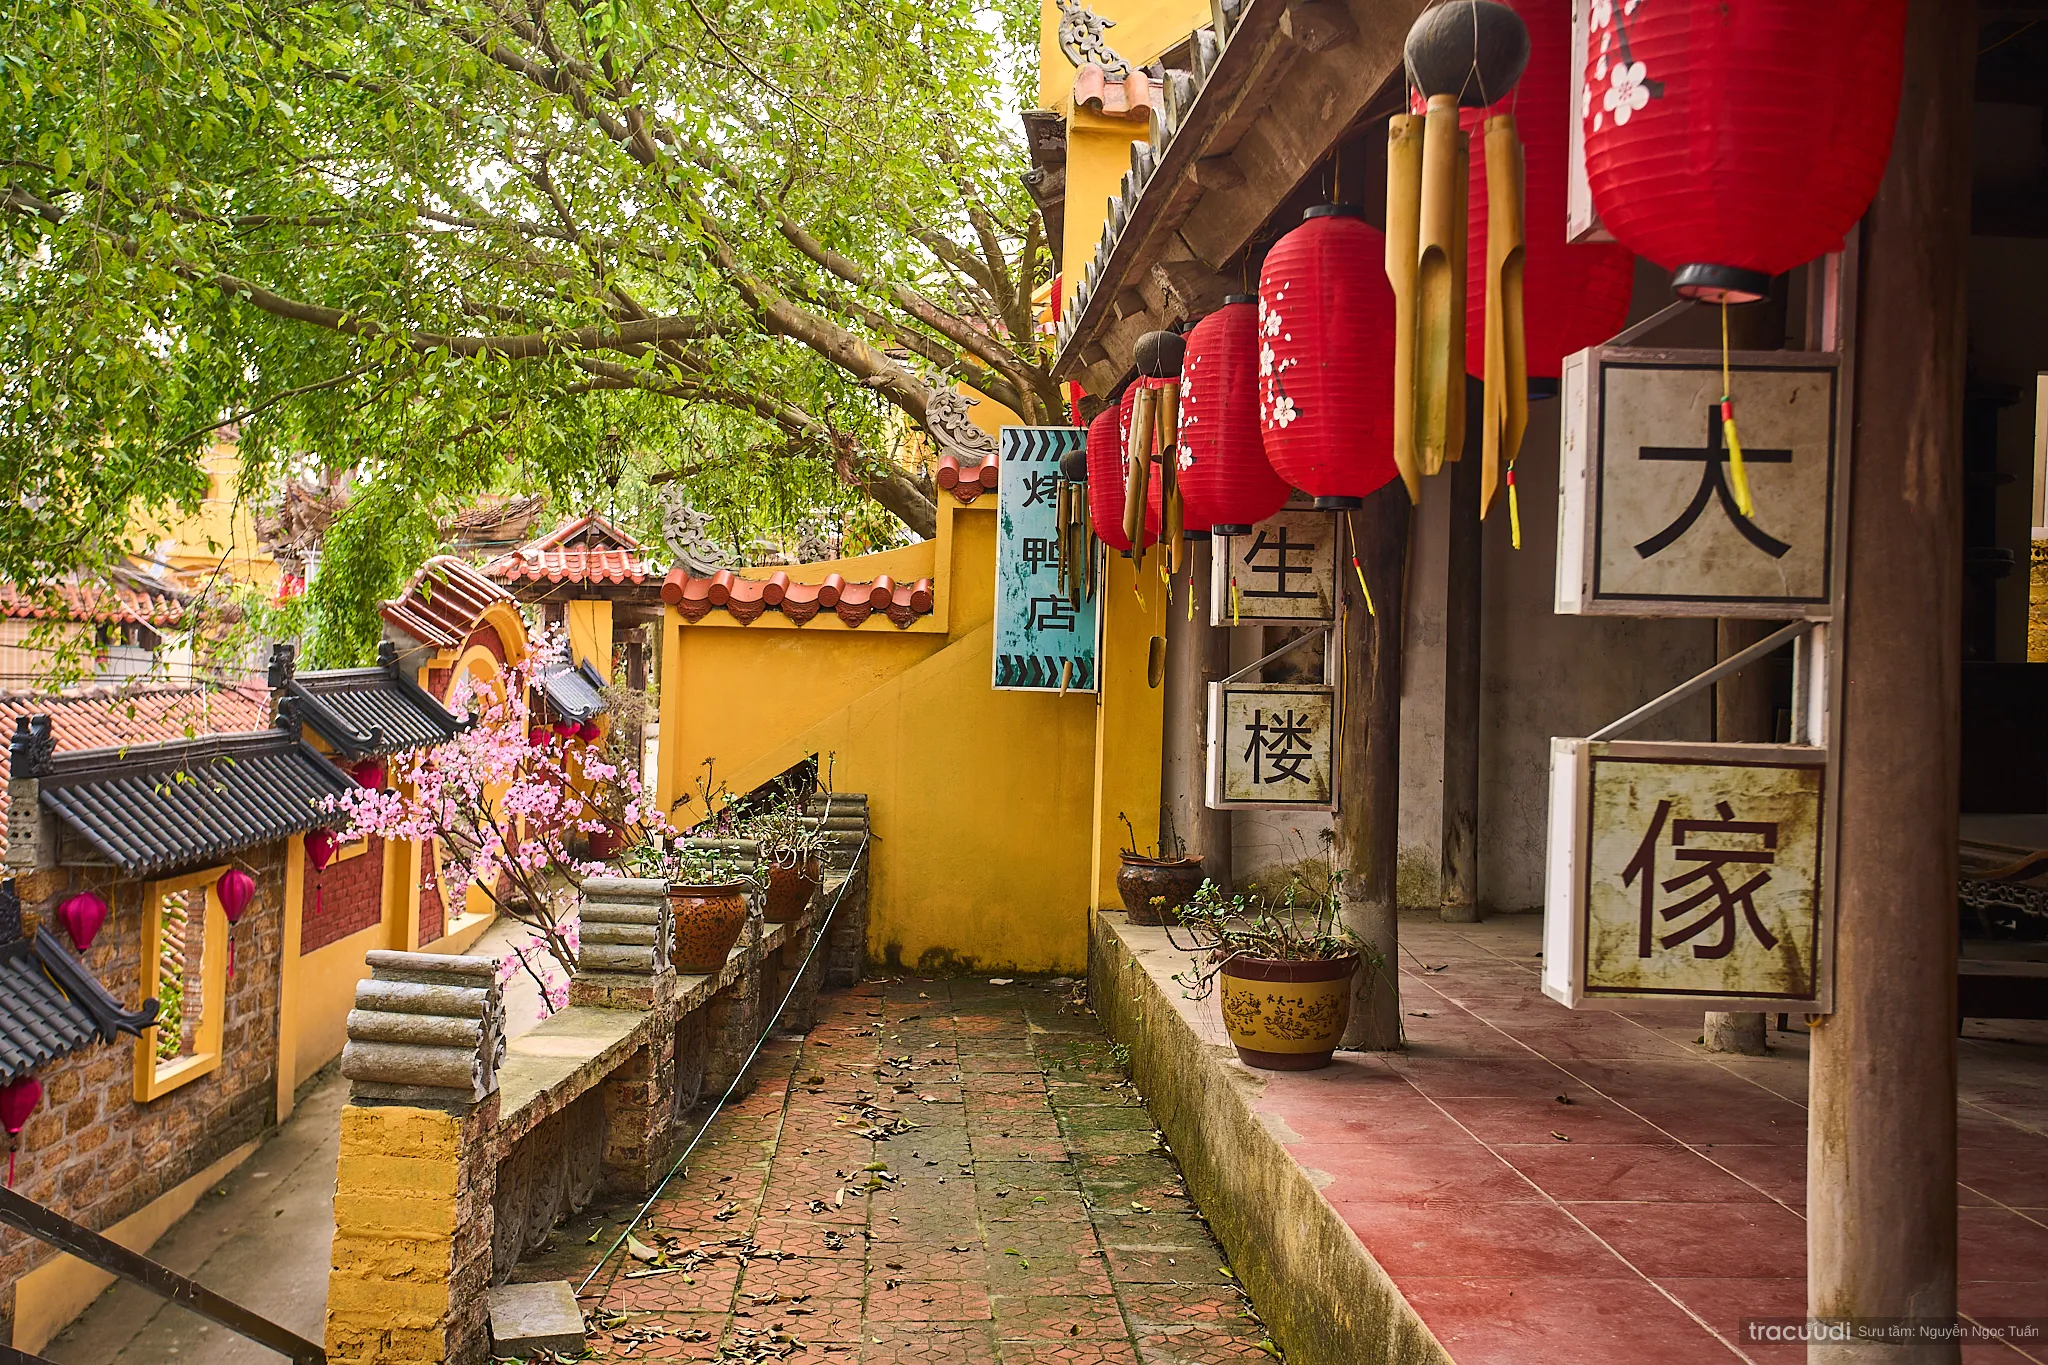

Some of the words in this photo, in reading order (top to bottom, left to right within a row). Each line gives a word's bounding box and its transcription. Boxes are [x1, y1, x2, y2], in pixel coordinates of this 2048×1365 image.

[1634, 404, 1793, 559] 大
[1243, 526, 1318, 598] 生
[1244, 709, 1313, 784] 楼
[1622, 799, 1779, 960] 傢
